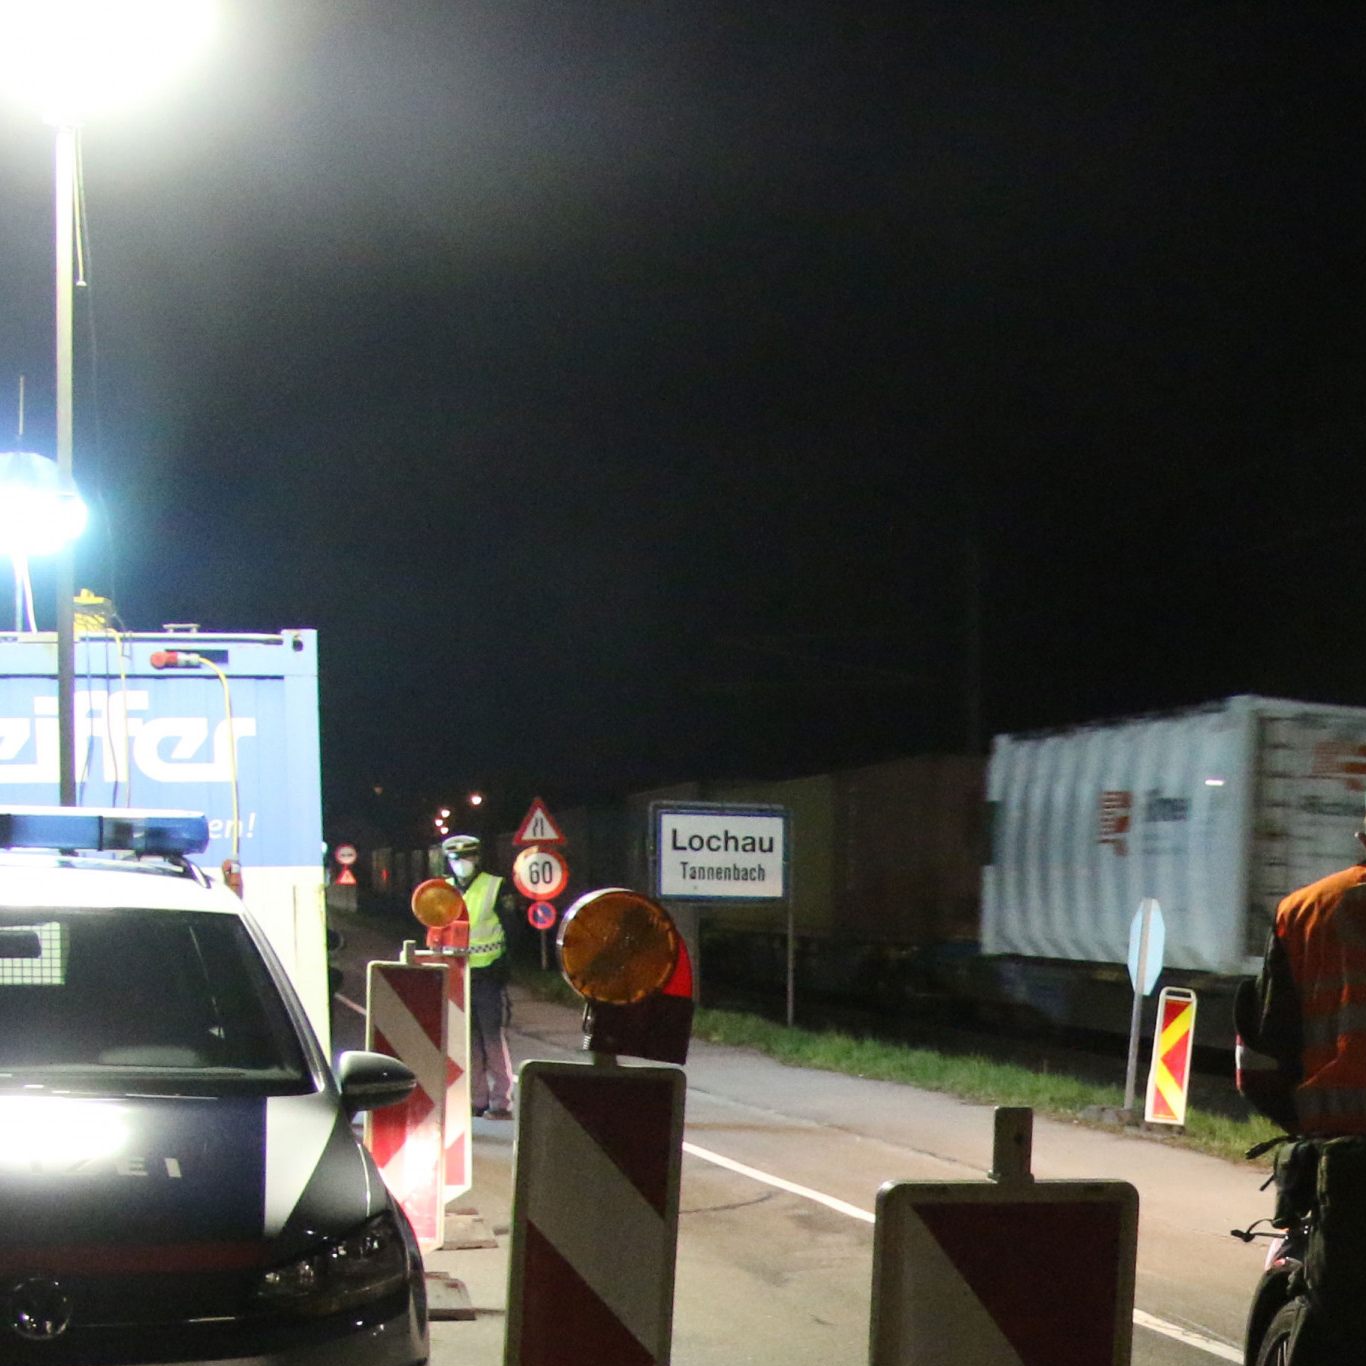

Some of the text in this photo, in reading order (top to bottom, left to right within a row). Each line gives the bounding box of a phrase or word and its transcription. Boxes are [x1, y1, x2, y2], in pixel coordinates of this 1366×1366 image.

[671, 828, 774, 853] Lochau
[529, 861, 553, 885] 60
[680, 861, 766, 881] Tannenbach
